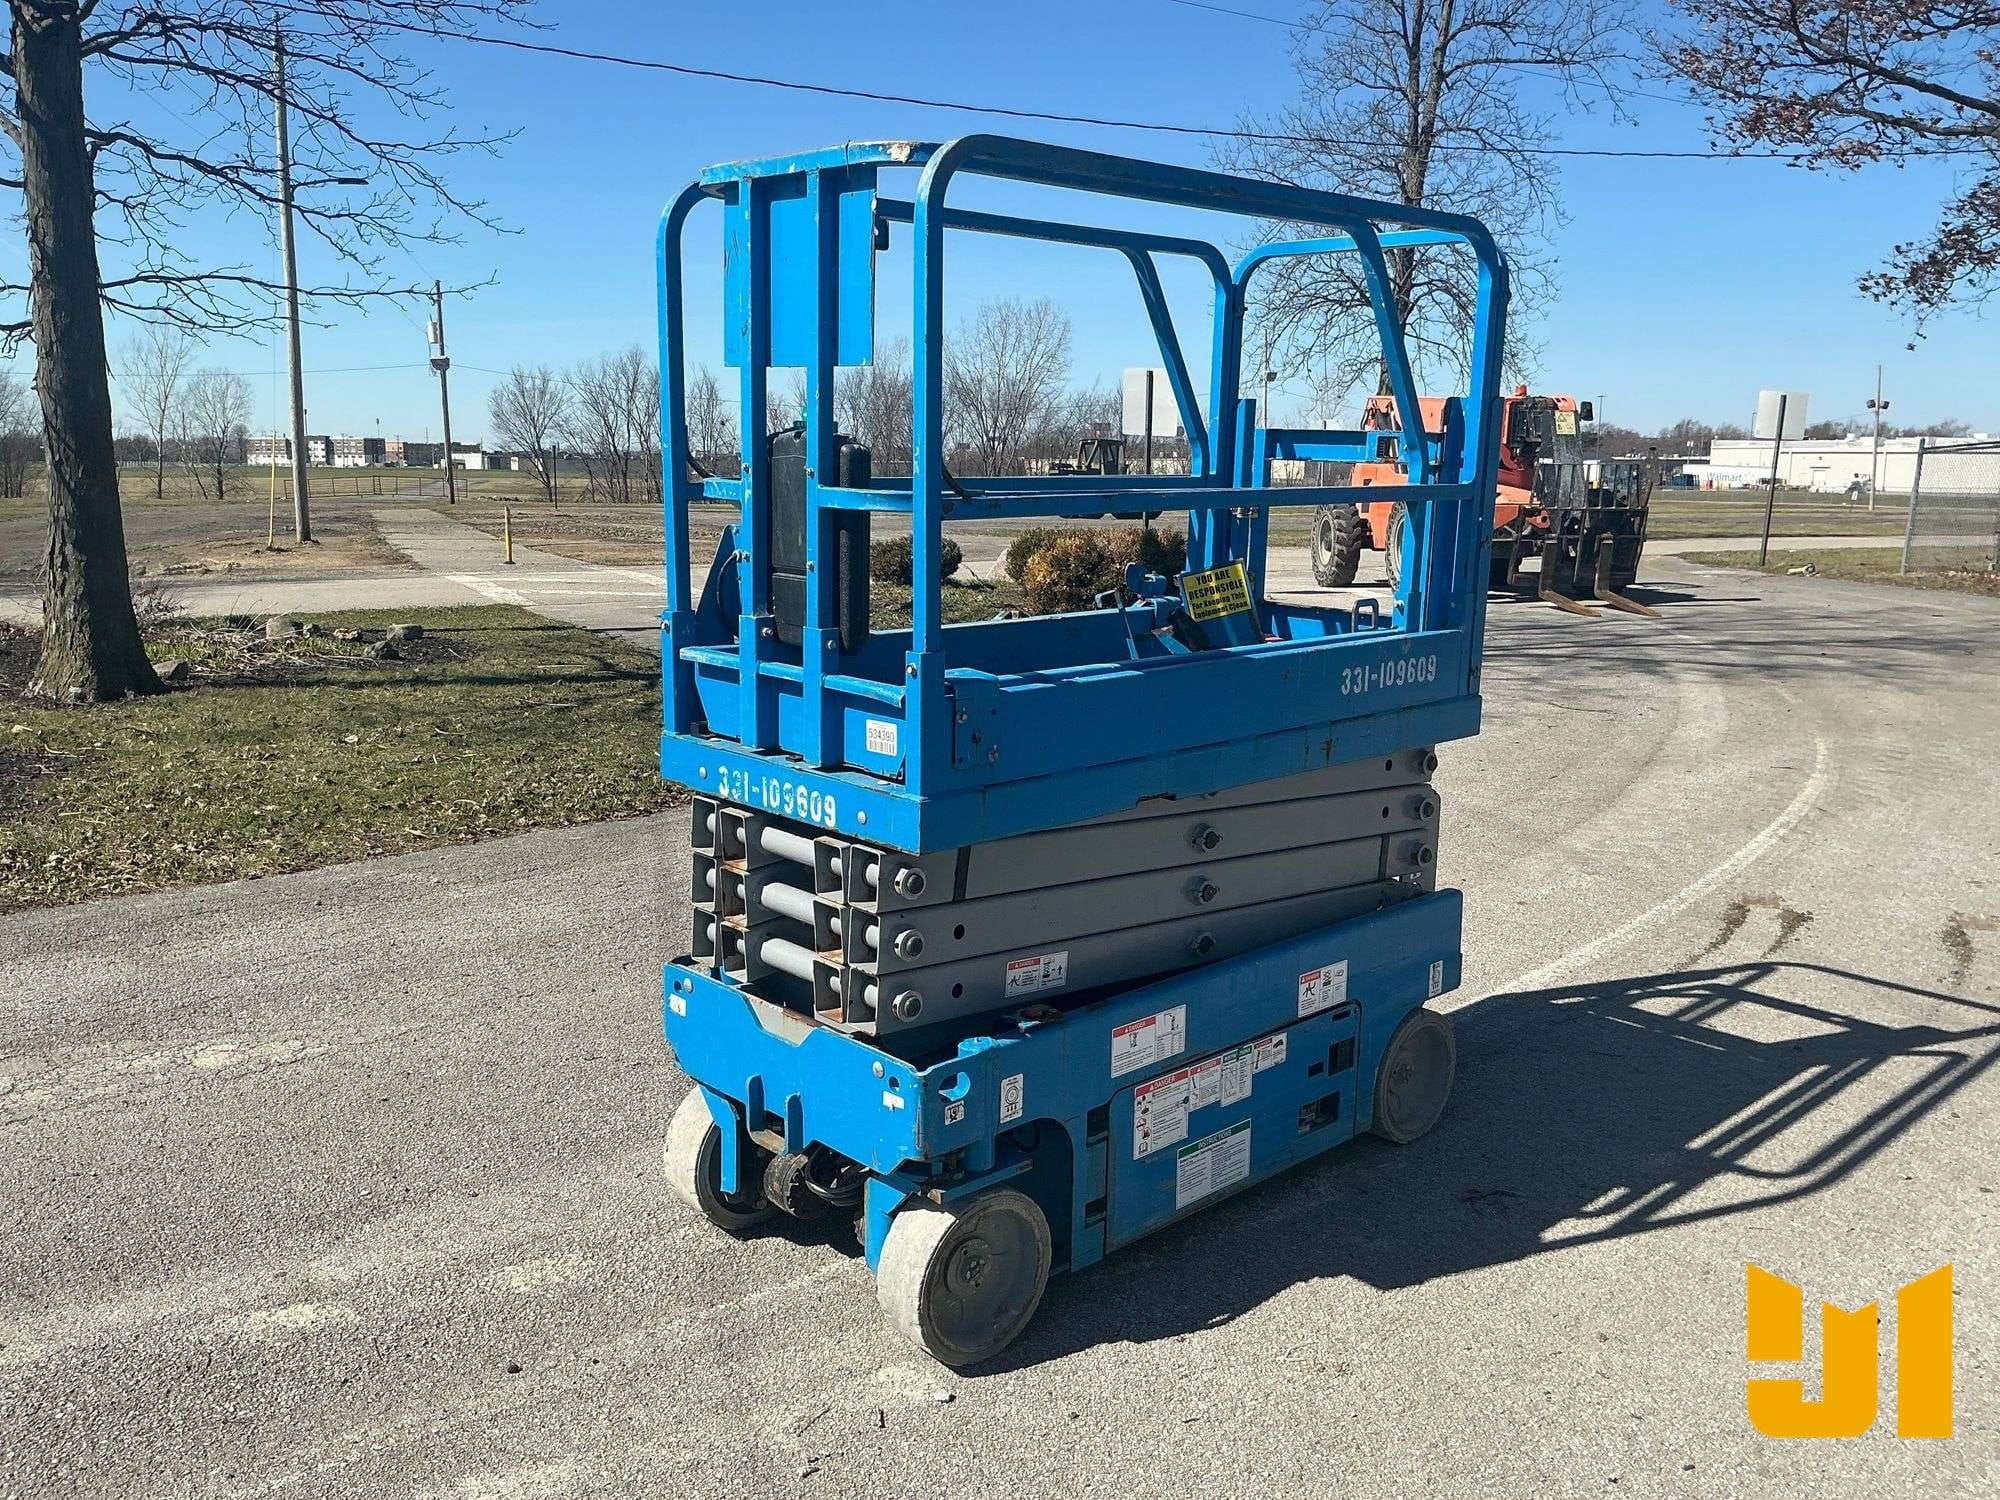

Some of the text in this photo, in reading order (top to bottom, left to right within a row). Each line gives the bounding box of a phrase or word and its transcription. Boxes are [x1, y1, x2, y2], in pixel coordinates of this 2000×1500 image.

[1195, 569, 1231, 585] YOU ARE
[1188, 579, 1244, 600] RESPONSIBLE
[1341, 654, 1437, 695] 331-109609
[718, 764, 837, 828] 331-109609
[1154, 1075, 1176, 1089] DANGER
